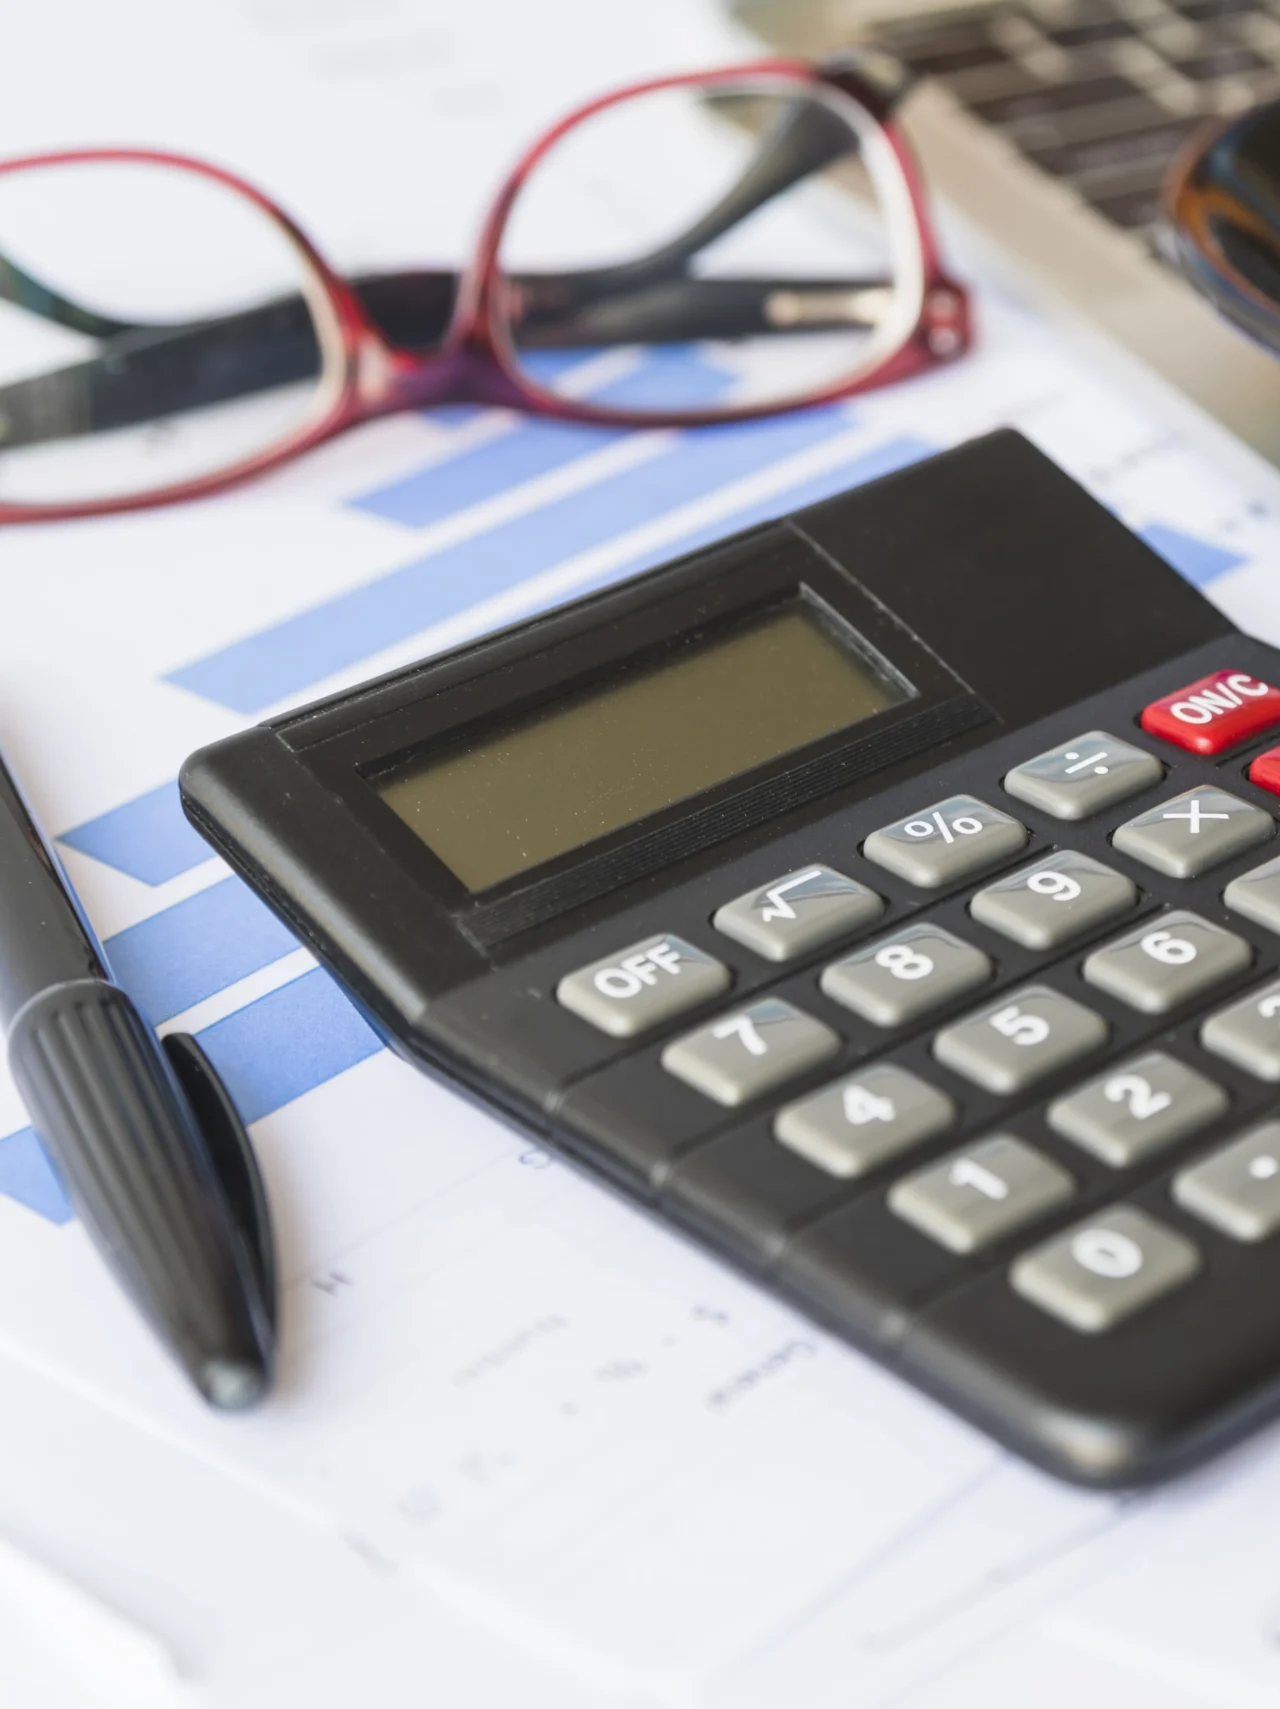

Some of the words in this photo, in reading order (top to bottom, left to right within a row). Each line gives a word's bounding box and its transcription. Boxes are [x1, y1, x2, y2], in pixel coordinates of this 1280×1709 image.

[1169, 673, 1270, 725] ON/C
[903, 811, 983, 844] %
[1026, 871, 1081, 902] 9
[875, 945, 934, 980] 8
[1140, 931, 1197, 964] 6
[592, 943, 683, 999] OFF
[711, 1015, 768, 1057] 7
[990, 1006, 1049, 1045] 5
[842, 1085, 896, 1126] 4
[1105, 1076, 1170, 1118] 2
[949, 1159, 1008, 1200] 1
[1073, 1231, 1141, 1277] 0
